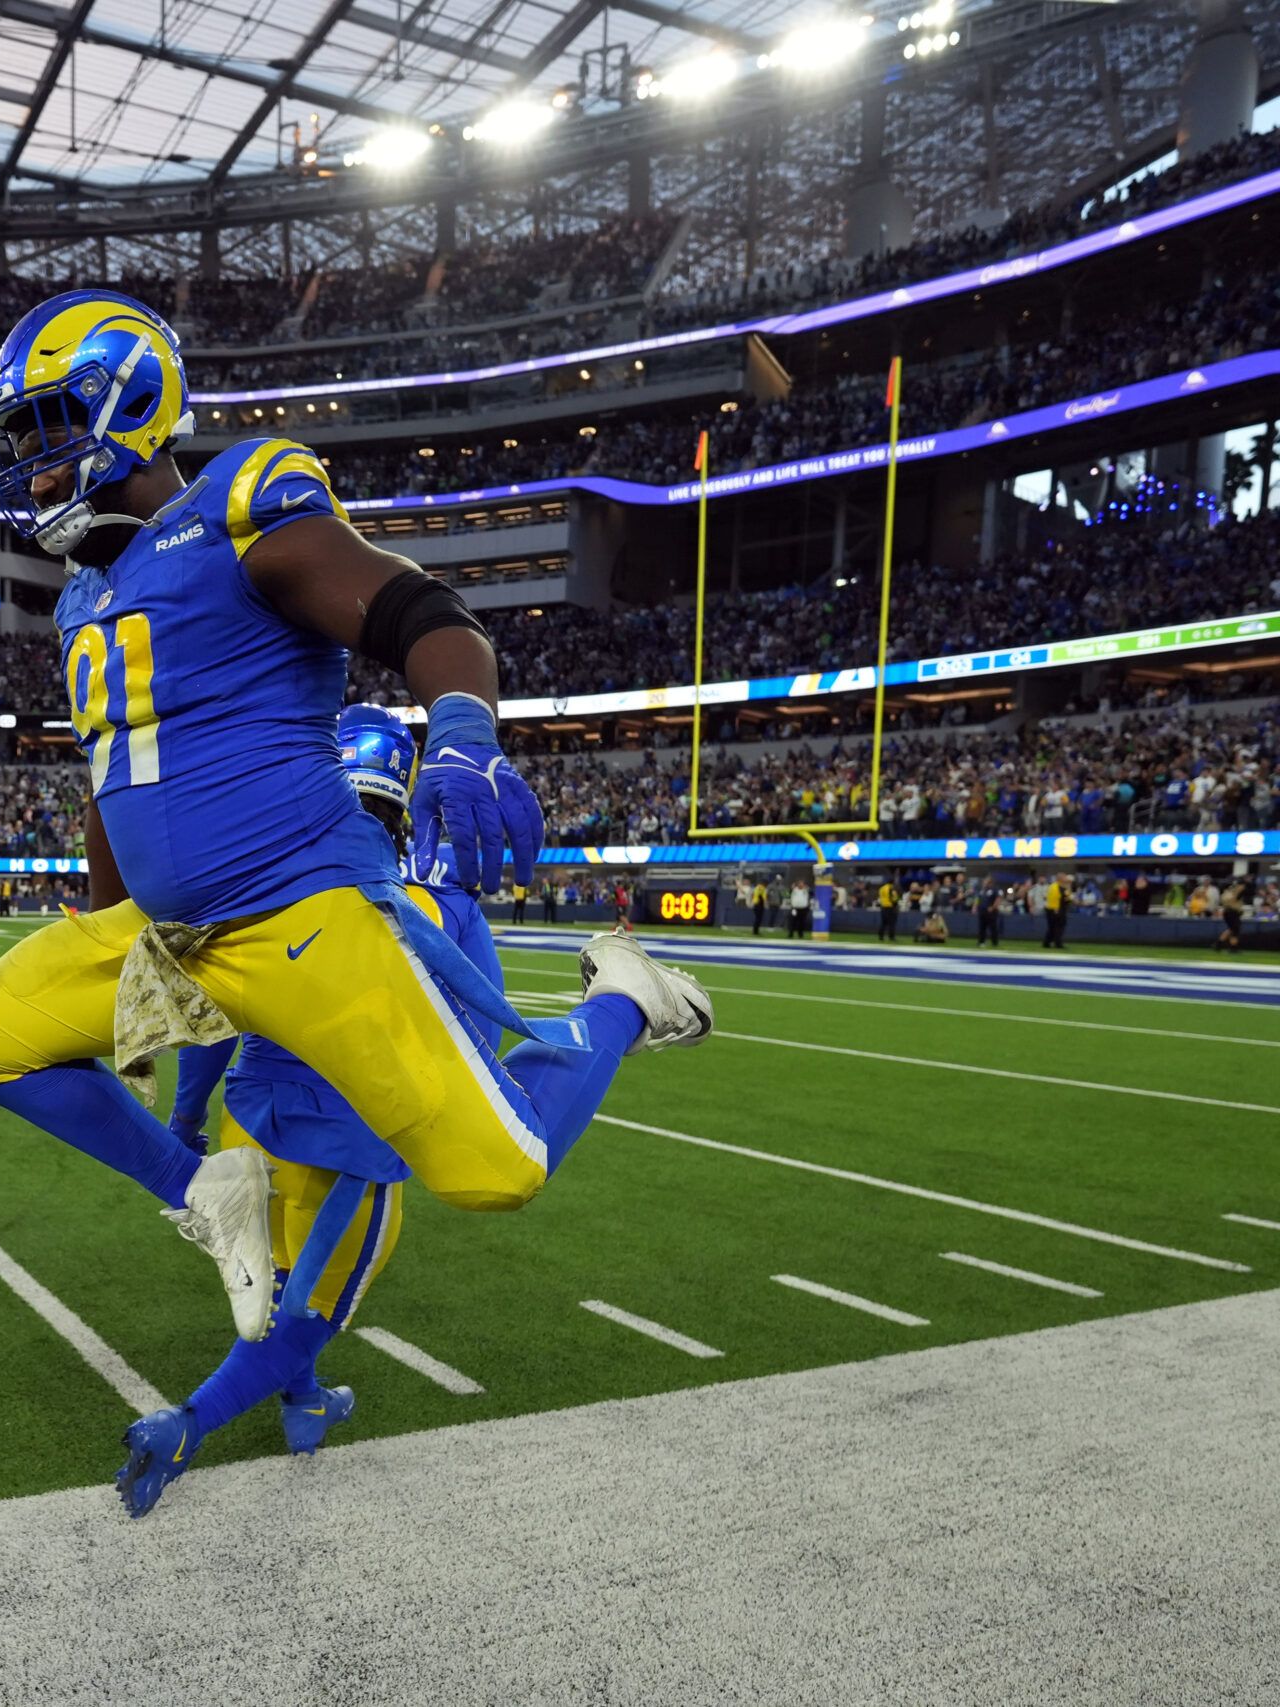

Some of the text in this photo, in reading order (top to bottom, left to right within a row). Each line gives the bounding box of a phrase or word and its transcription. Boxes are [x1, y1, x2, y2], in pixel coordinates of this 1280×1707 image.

[668, 485, 689, 501] LIVE
[752, 470, 774, 484] AND
[775, 464, 798, 480] LIFE
[800, 460, 825, 475] WILL
[828, 453, 860, 470] TREAT
[863, 448, 885, 463] YOU
[155, 523, 204, 552] RAMS
[67, 612, 161, 797] 91
[356, 780, 404, 798] ANGELES
[945, 831, 1280, 859] RAMS HOUS
[660, 892, 709, 920] 0:03
